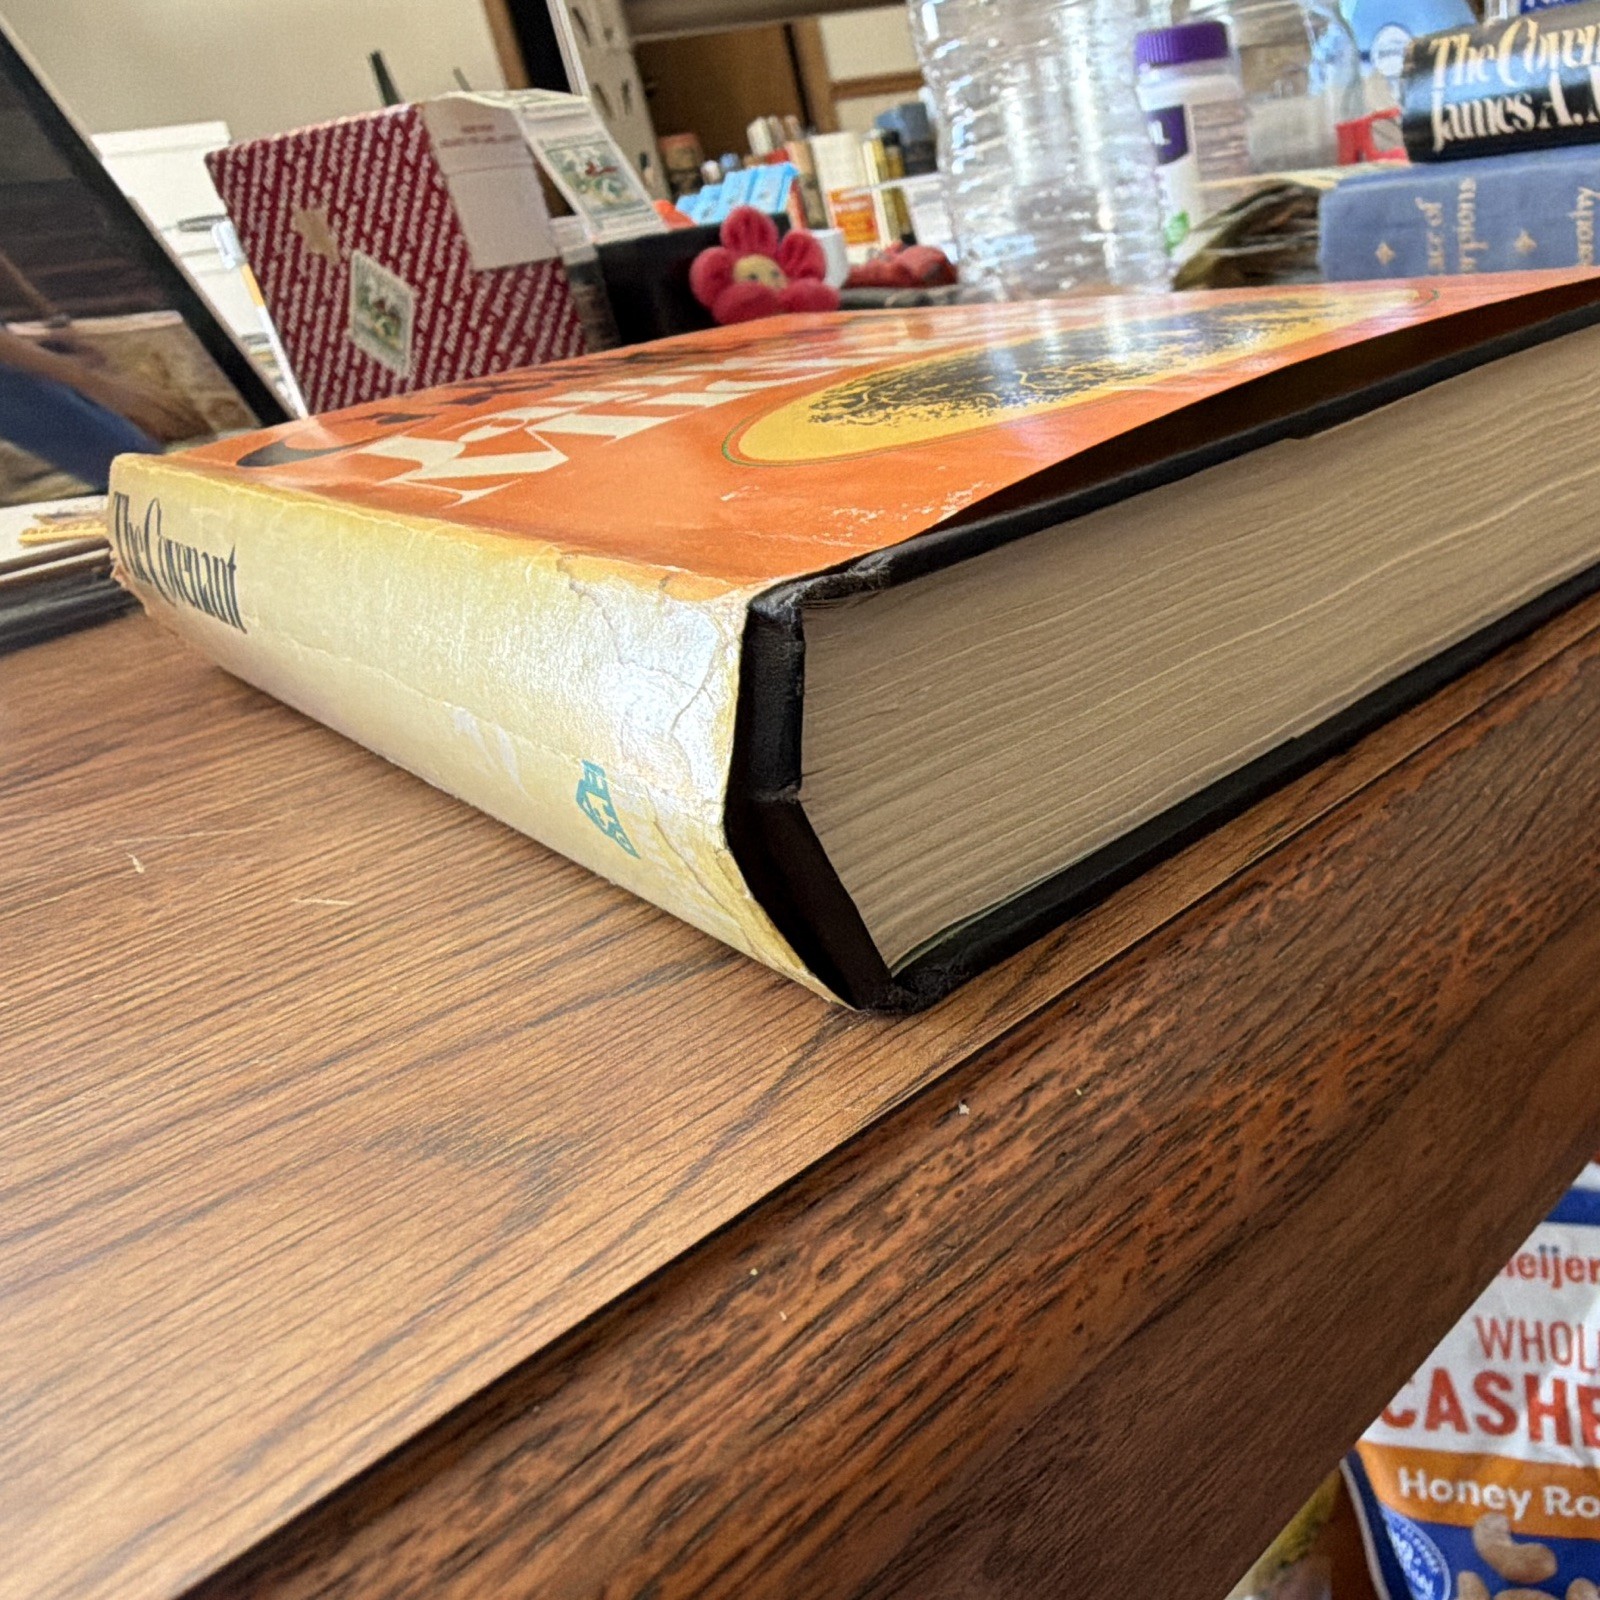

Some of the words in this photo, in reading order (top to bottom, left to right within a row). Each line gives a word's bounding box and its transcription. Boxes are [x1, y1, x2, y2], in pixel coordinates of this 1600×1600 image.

[1429, 33, 1496, 88] The
[1432, 89, 1535, 154] James
[1414, 196, 1443, 227] of
[114, 491, 152, 584] The
[144, 497, 248, 634] Covenant
[1505, 1244, 1600, 1289] eijer
[1474, 1314, 1600, 1376] WHOL
[1398, 1465, 1531, 1521] Honey
[1544, 1485, 1600, 1518] Ro
